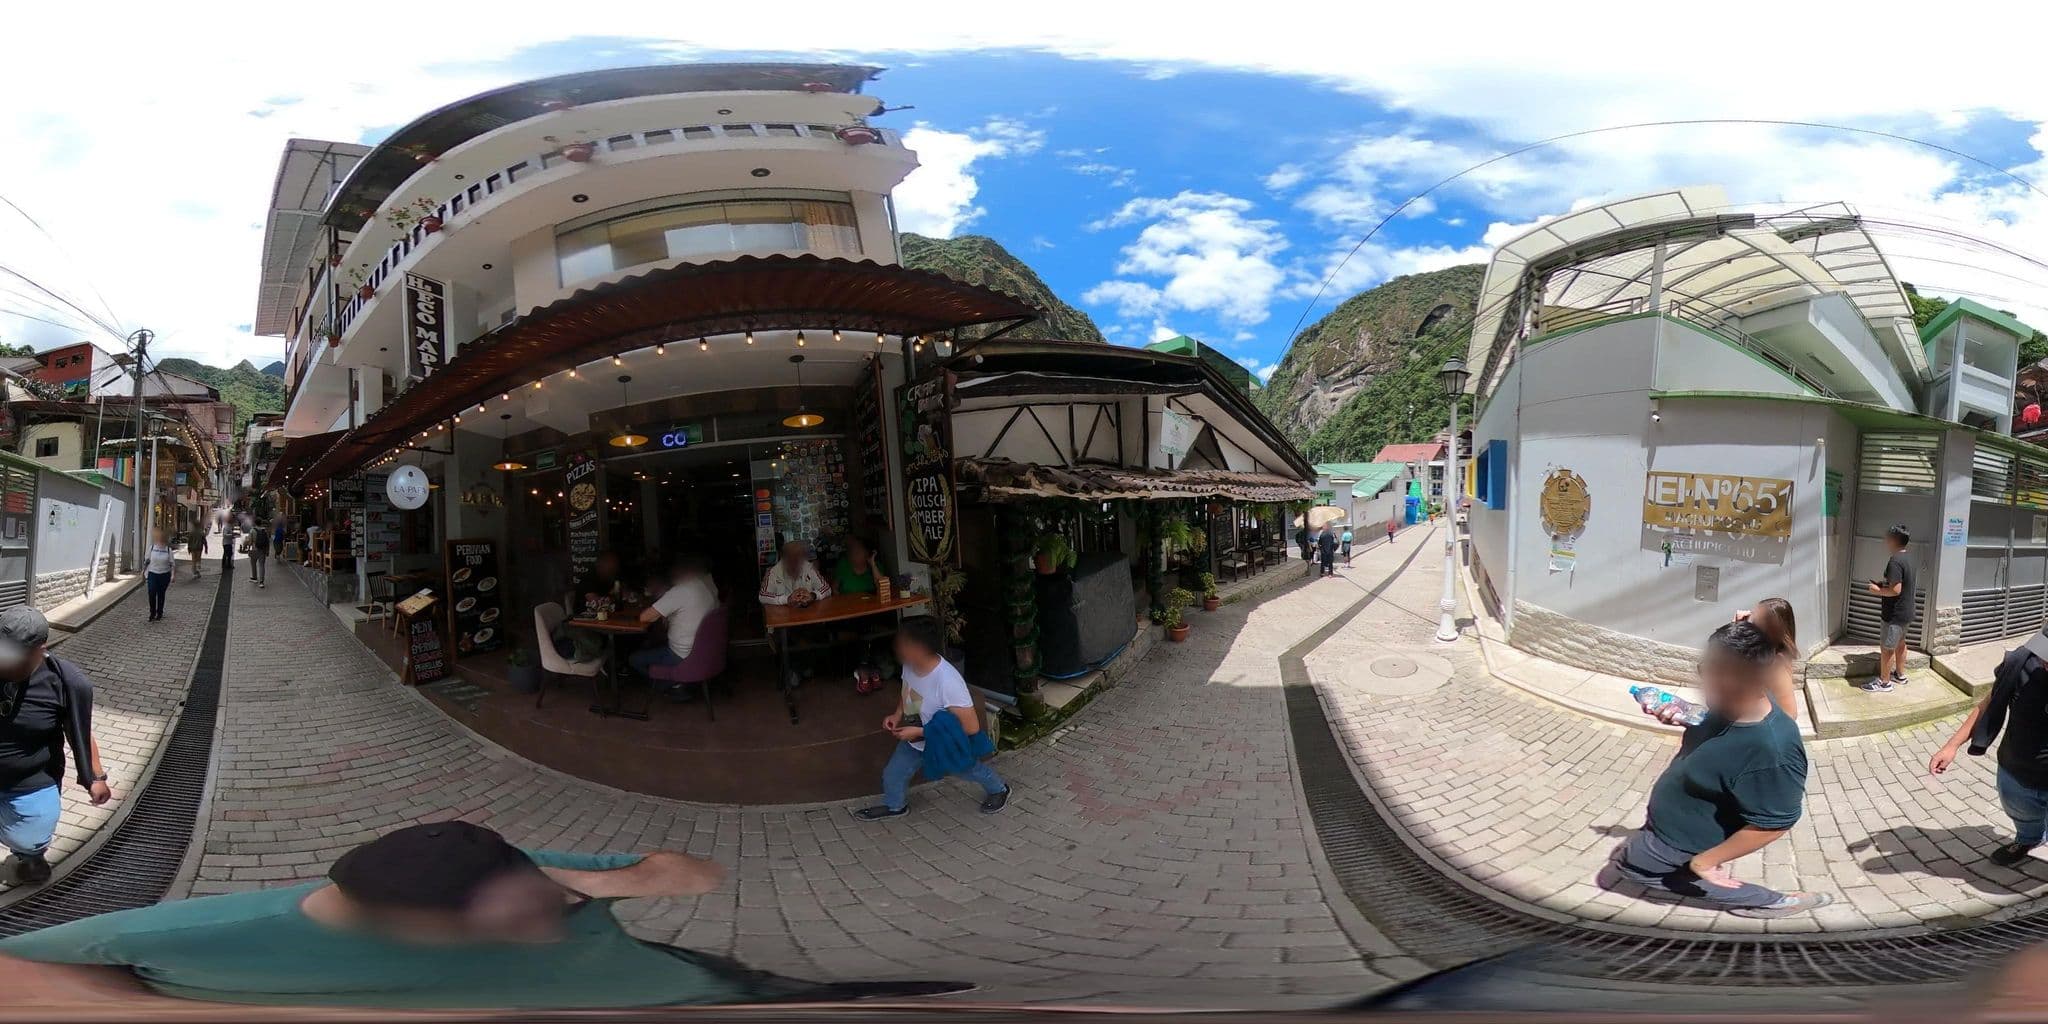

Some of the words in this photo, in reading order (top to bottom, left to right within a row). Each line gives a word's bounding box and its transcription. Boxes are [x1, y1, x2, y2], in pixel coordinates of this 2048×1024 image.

[566, 460, 596, 484] PIZZAS
[916, 475, 938, 493] IPA
[912, 493, 946, 508] KOLSCH
[909, 510, 945, 526] AMBER
[924, 526, 943, 540] ALE
[456, 544, 491, 556] PERUVIAN
[466, 555, 482, 566] FOOD
